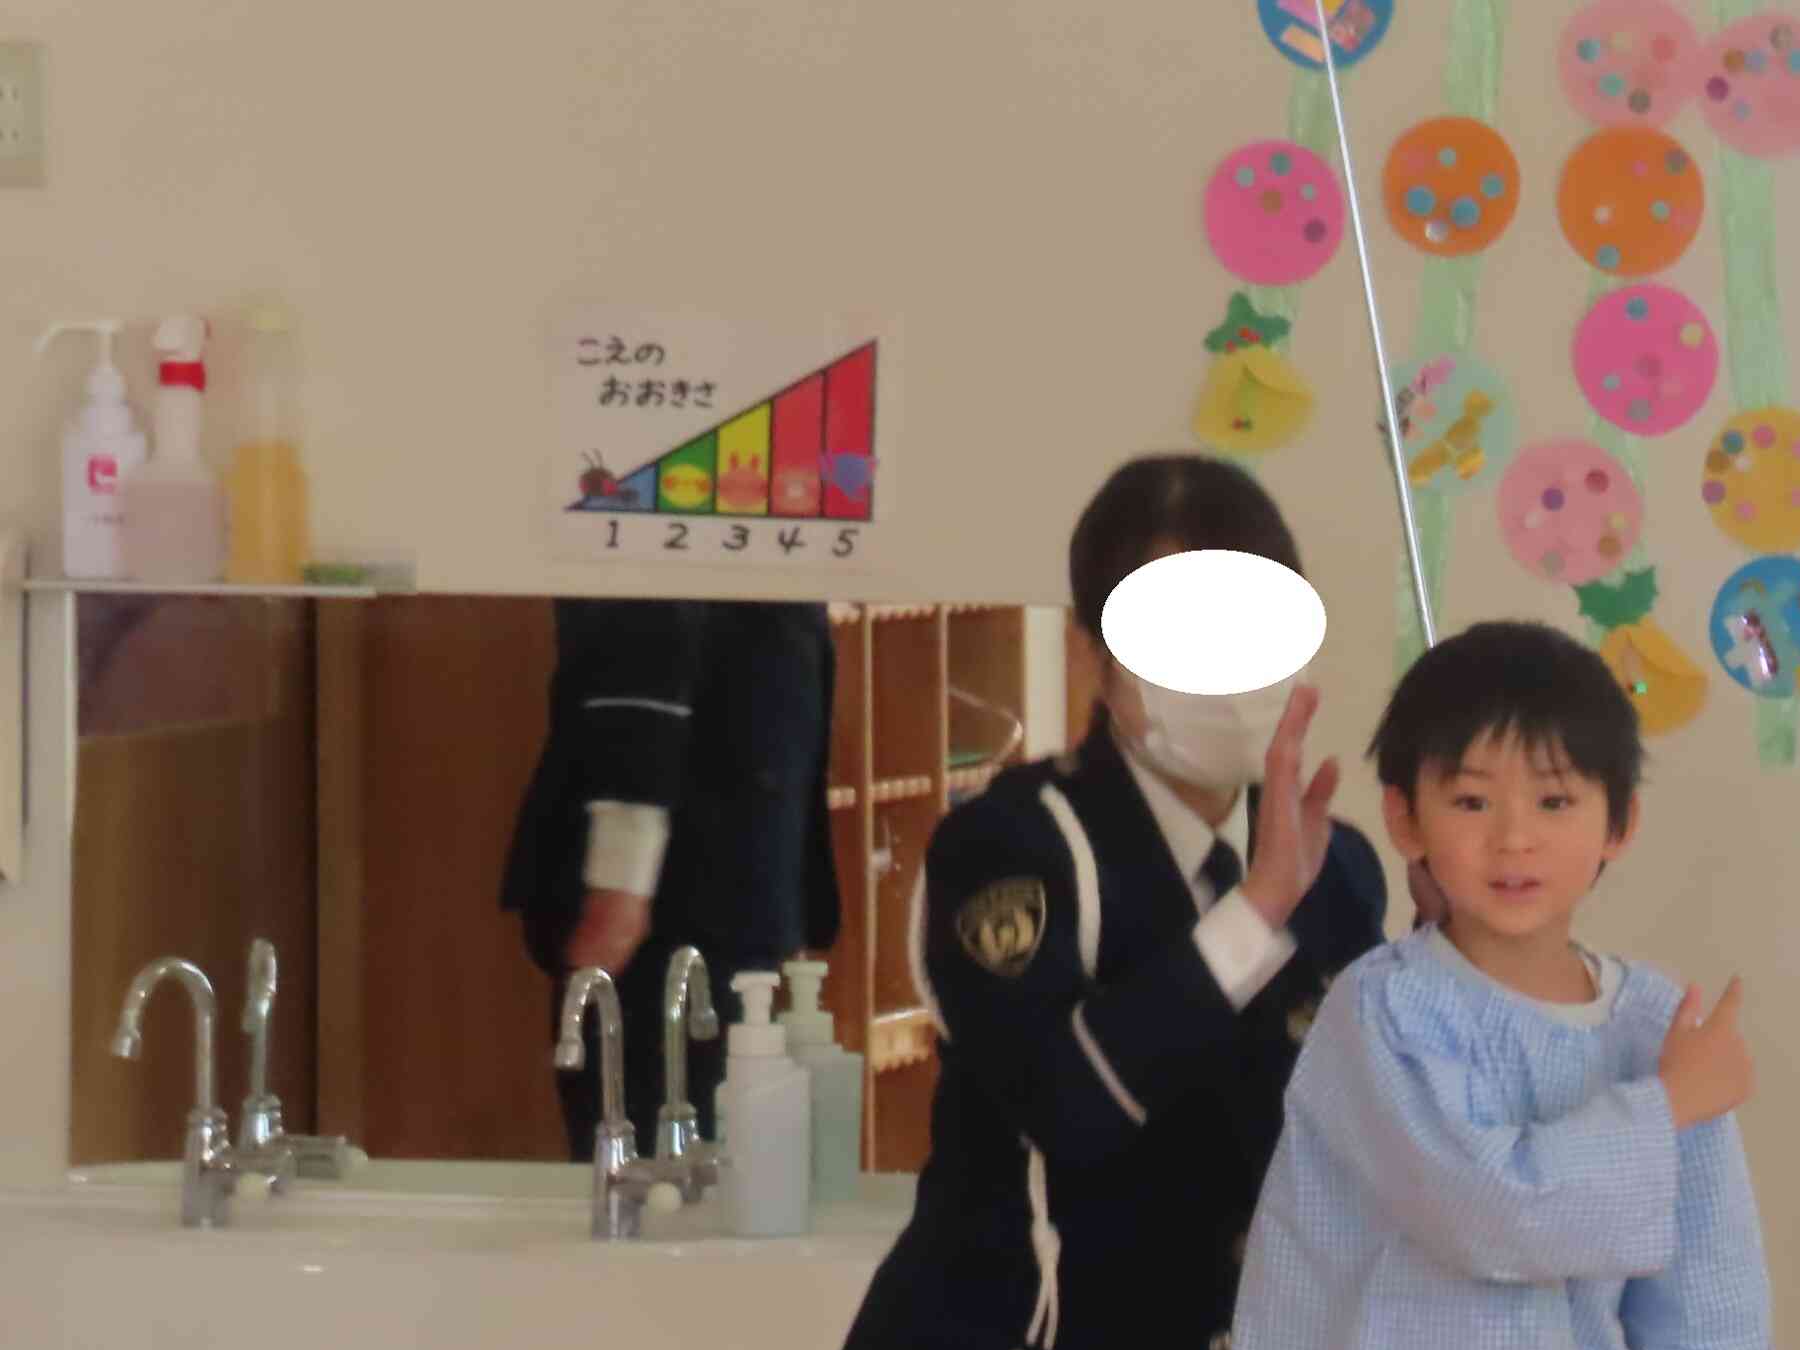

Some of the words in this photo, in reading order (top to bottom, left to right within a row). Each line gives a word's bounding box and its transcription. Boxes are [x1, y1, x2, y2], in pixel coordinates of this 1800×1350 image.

[576, 336, 666, 366] こえの
[598, 375, 717, 408] おおきさ
[605, 520, 620, 548] 1
[663, 523, 690, 550] 2
[721, 526, 751, 552] 3
[777, 527, 806, 555] 4
[831, 529, 860, 558] 5
